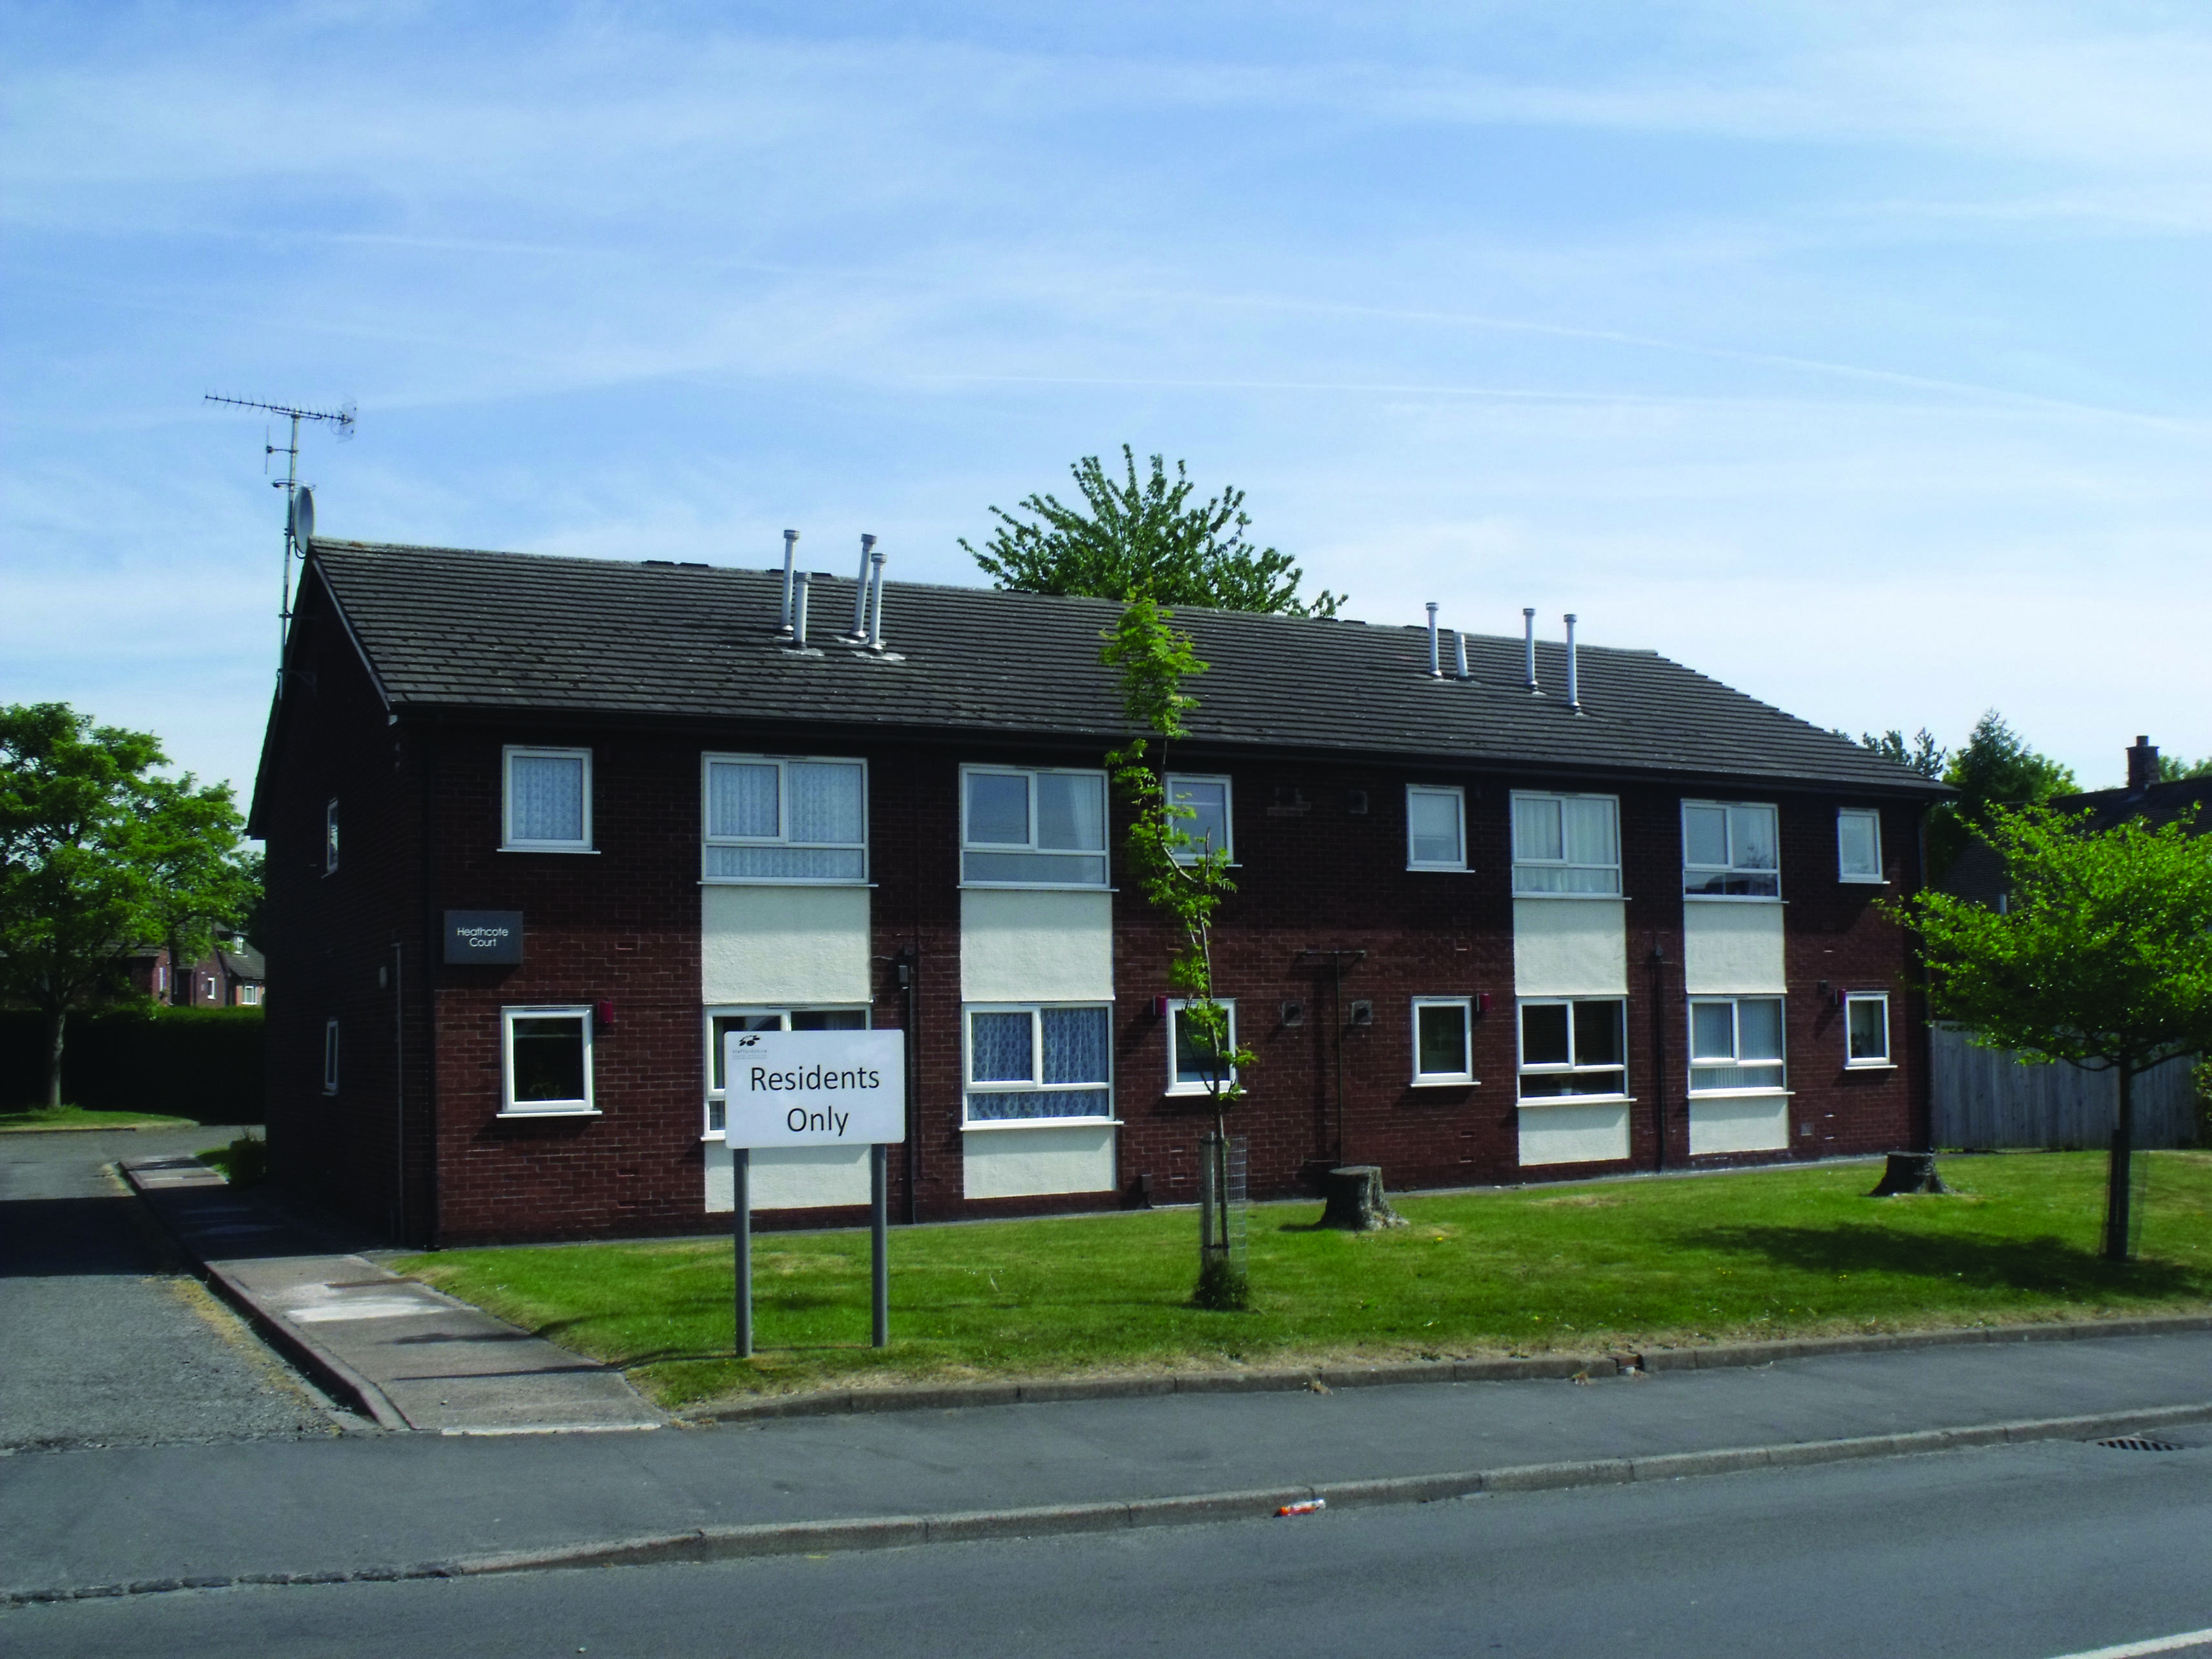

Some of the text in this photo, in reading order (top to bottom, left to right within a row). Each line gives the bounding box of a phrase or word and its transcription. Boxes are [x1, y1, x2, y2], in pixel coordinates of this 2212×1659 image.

[457, 927, 509, 936] Heathcote
[470, 938, 497, 947] Court
[751, 1065, 880, 1091] Residents
[787, 1106, 849, 1136] Only
